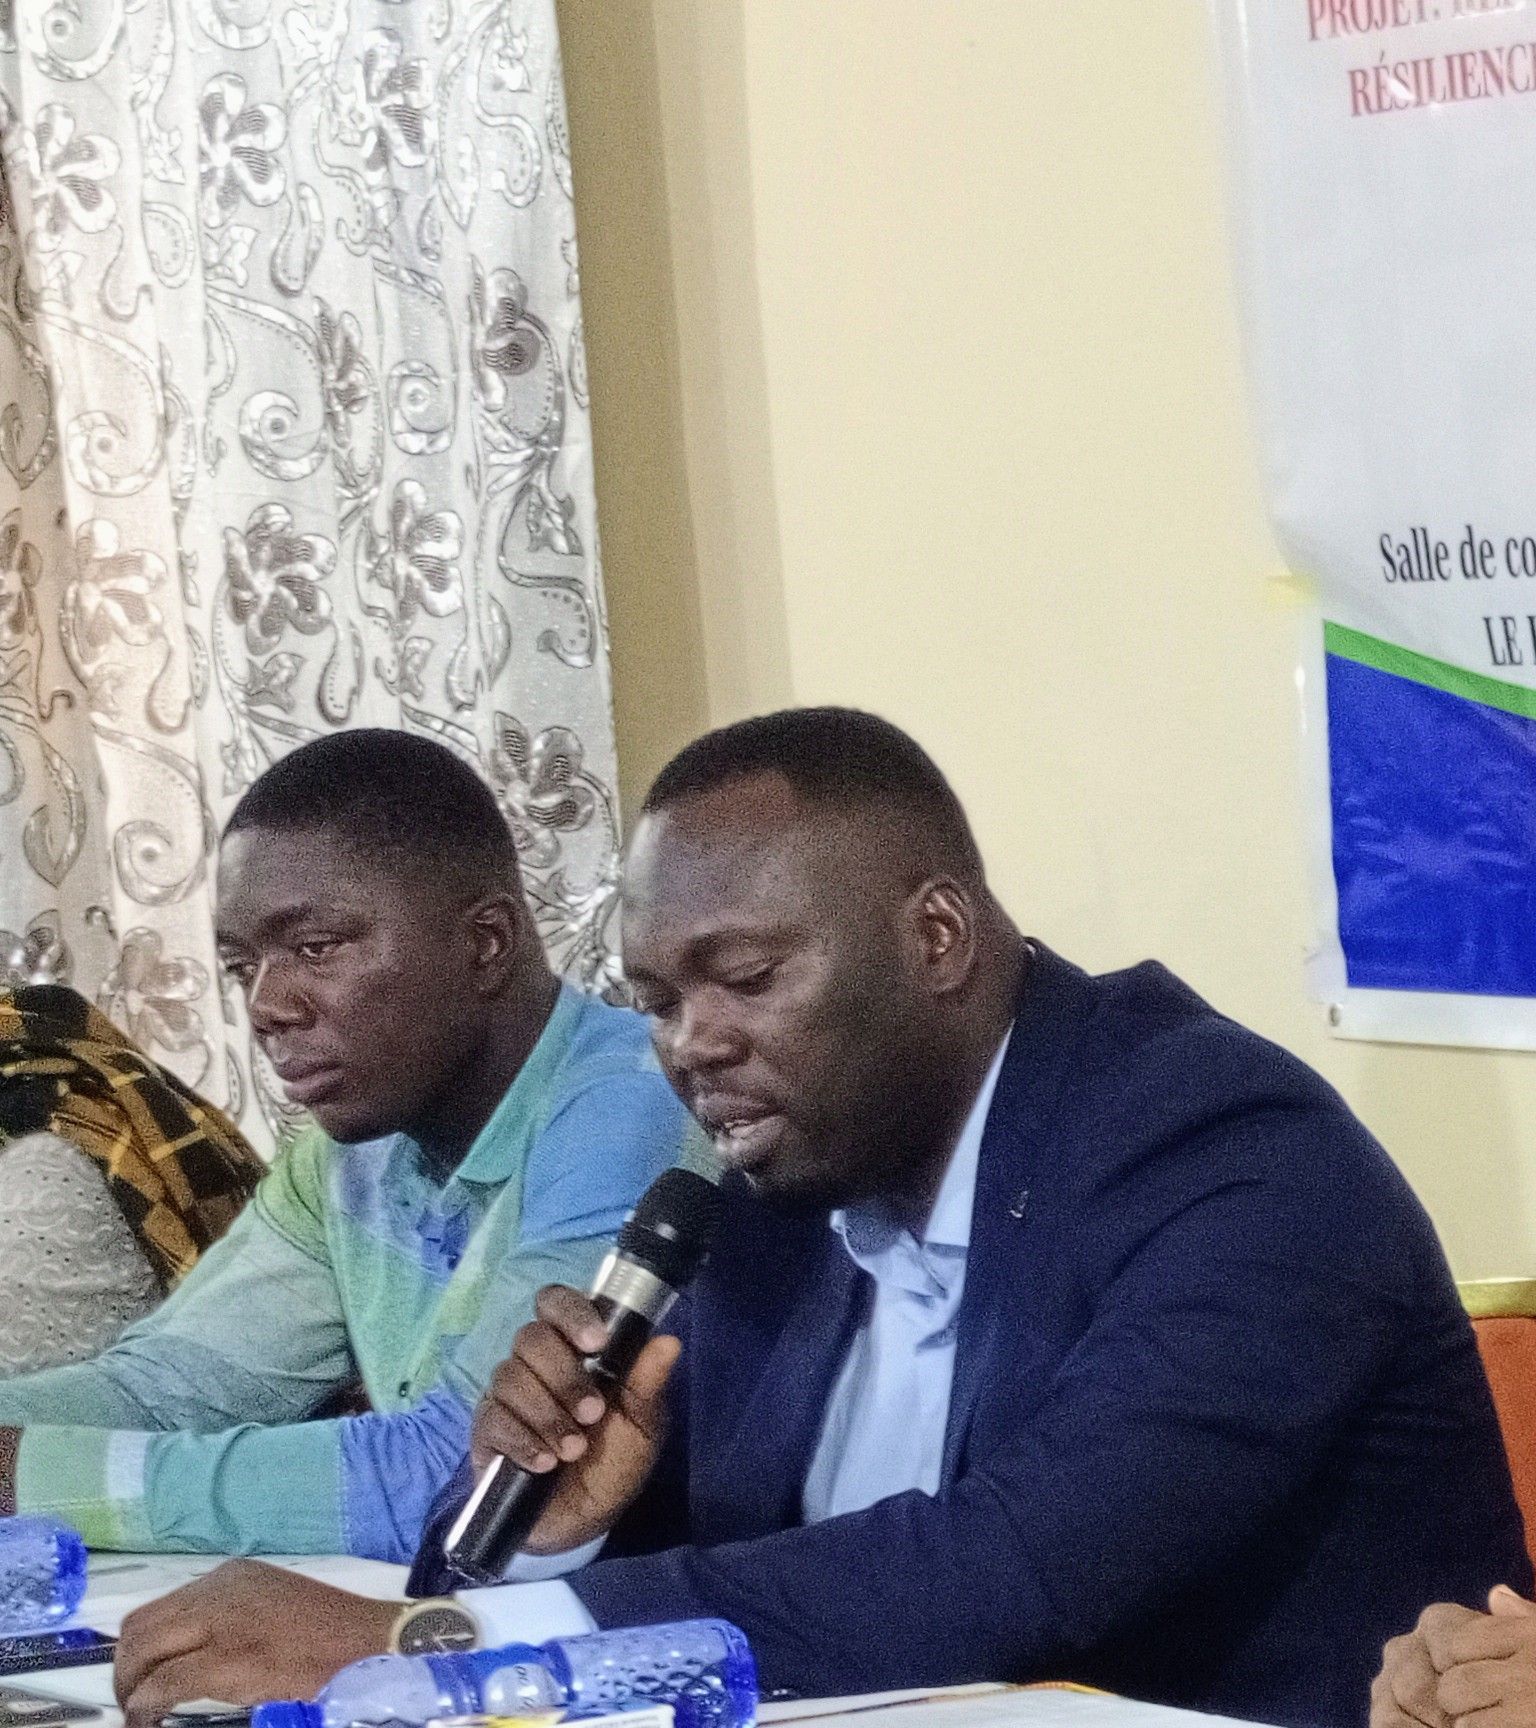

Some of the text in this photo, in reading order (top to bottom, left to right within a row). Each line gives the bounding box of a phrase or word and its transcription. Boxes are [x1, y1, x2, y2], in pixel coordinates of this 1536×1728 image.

[1380, 526, 1451, 584] Salle
[1459, 524, 1497, 580] de
[1482, 614, 1524, 667] LE
